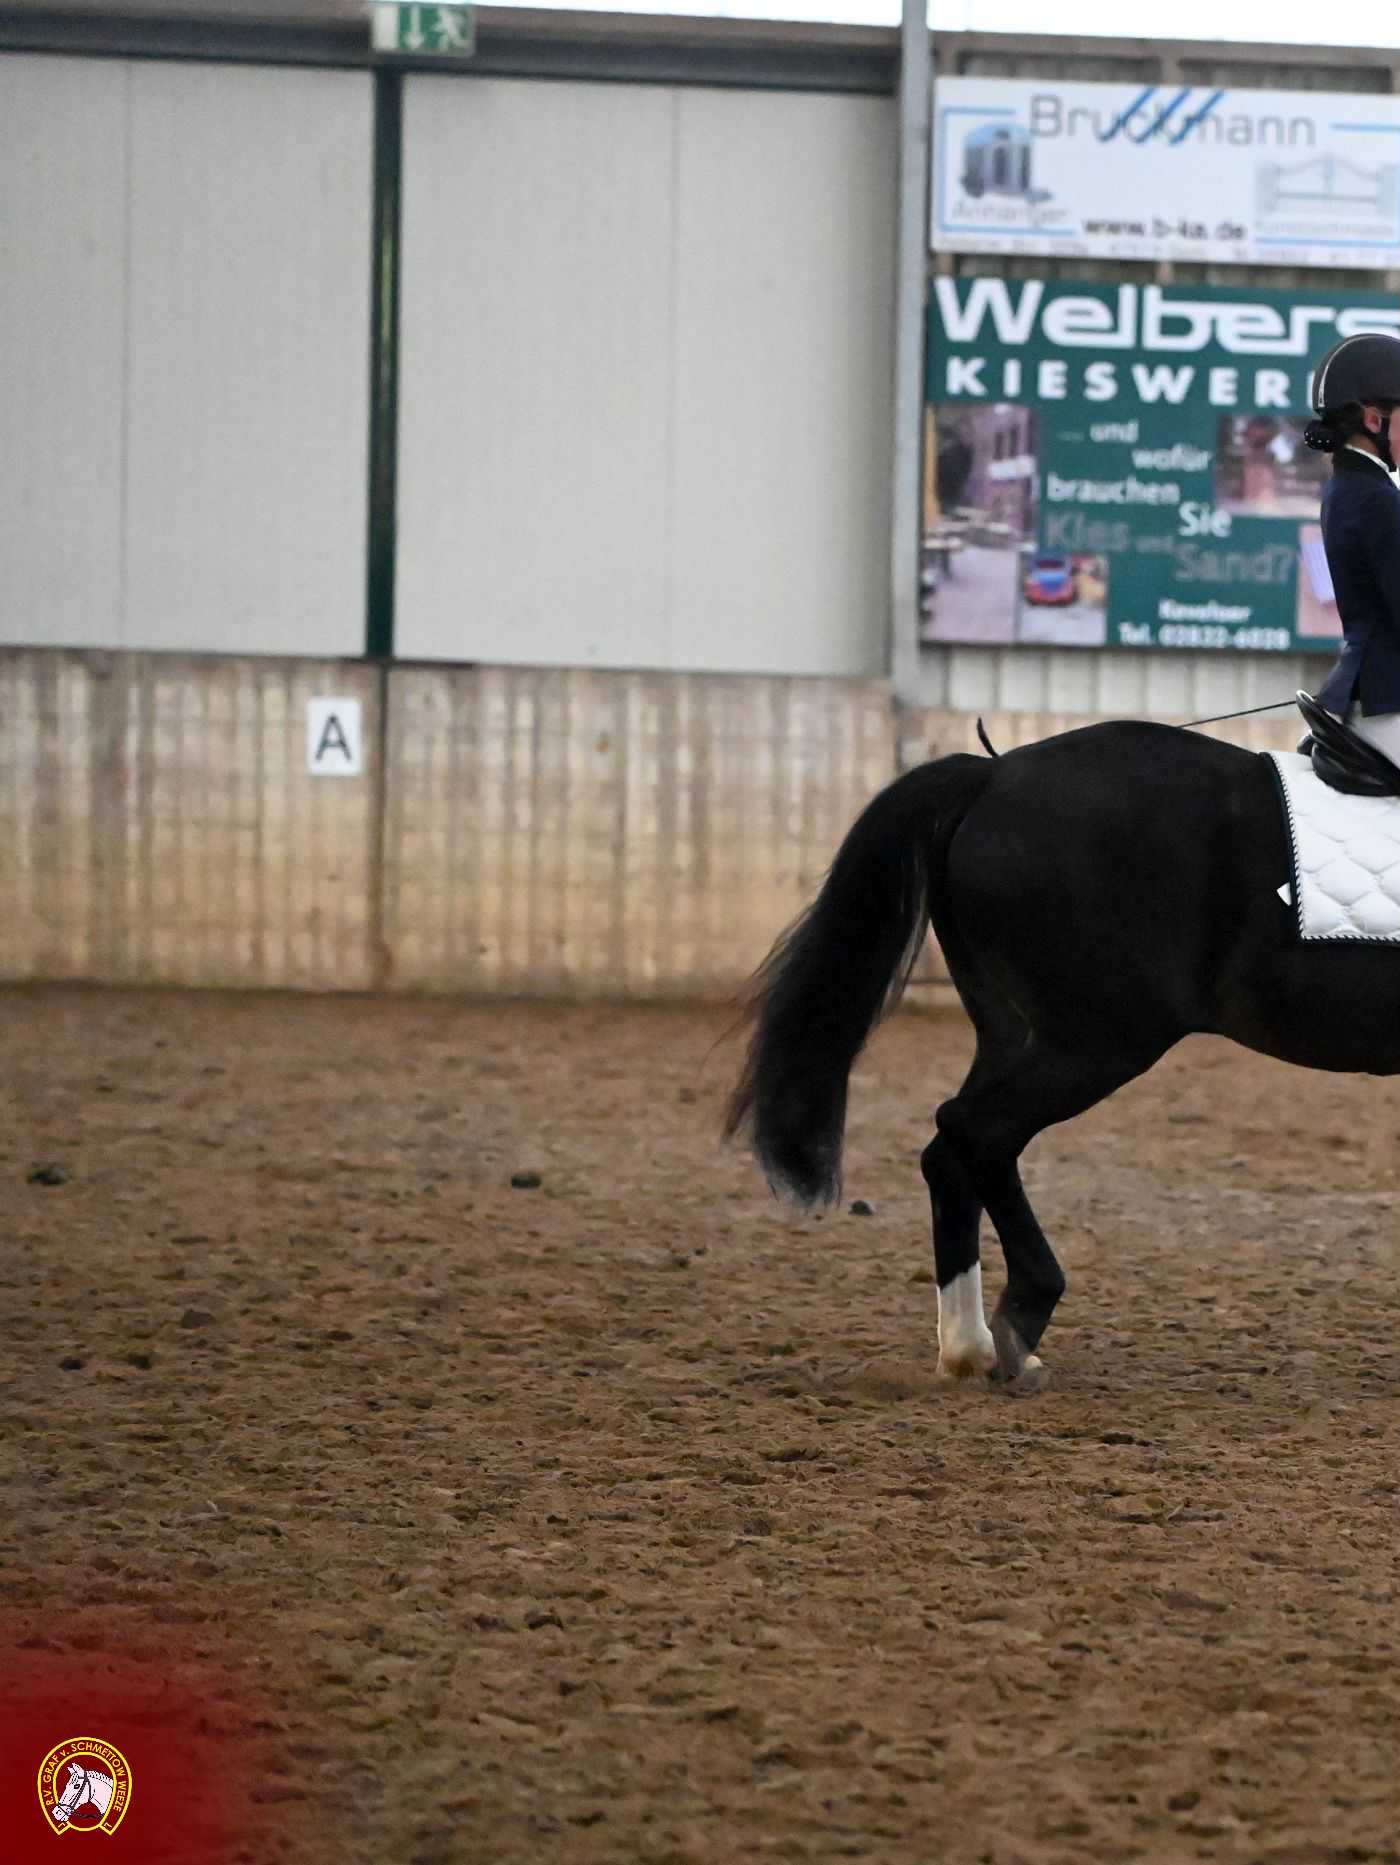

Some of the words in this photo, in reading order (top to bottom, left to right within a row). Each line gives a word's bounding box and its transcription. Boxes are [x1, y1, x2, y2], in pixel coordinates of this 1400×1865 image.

[945, 356, 1316, 409] KIESWER
[1047, 474, 1181, 504] brauchen
[1046, 513, 1129, 551] Kies
[1178, 501, 1234, 538] Sie
[315, 715, 352, 763] A
